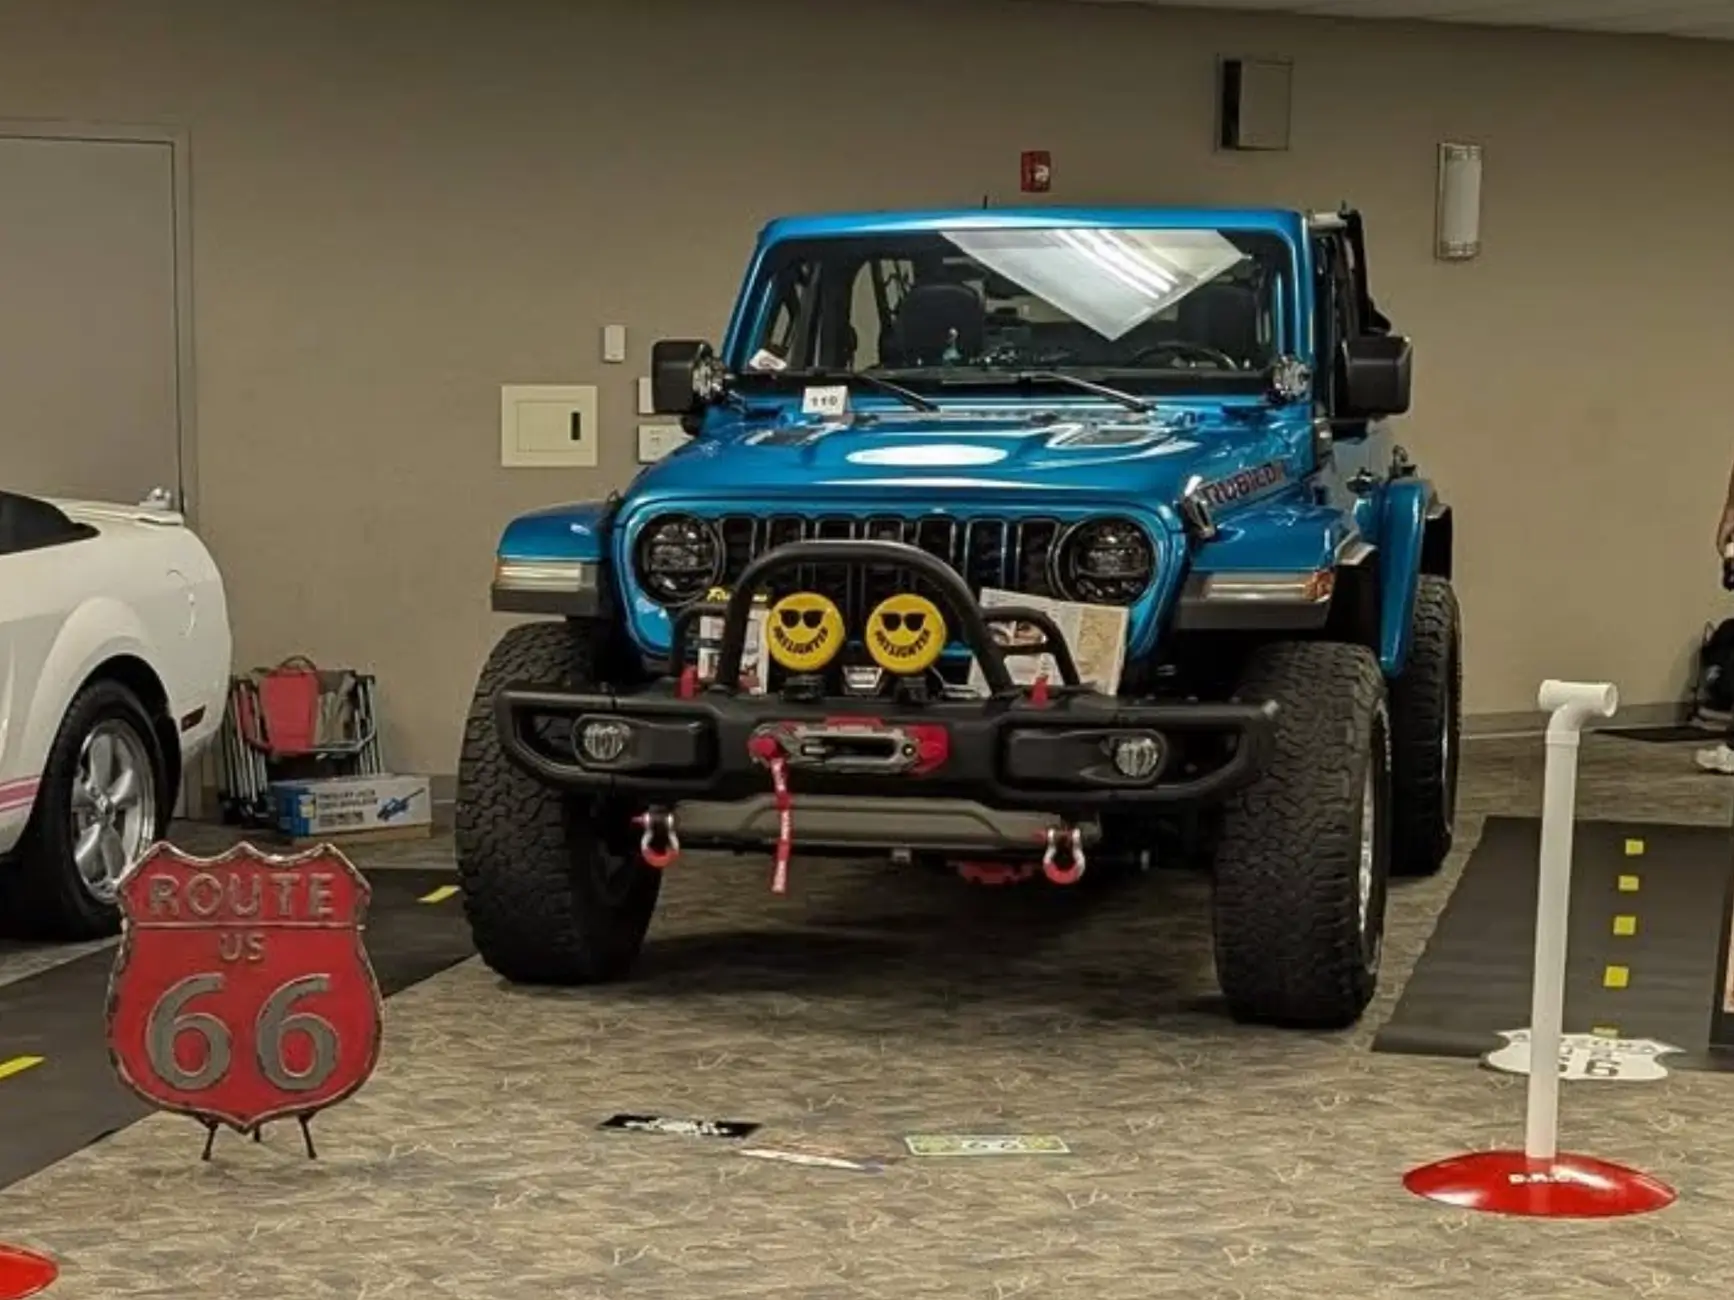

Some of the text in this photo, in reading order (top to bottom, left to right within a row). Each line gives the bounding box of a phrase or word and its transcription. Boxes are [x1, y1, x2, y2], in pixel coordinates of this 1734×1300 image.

[149, 873, 335, 917] ROUTE
[219, 932, 266, 960] US
[145, 972, 340, 1091] 66
